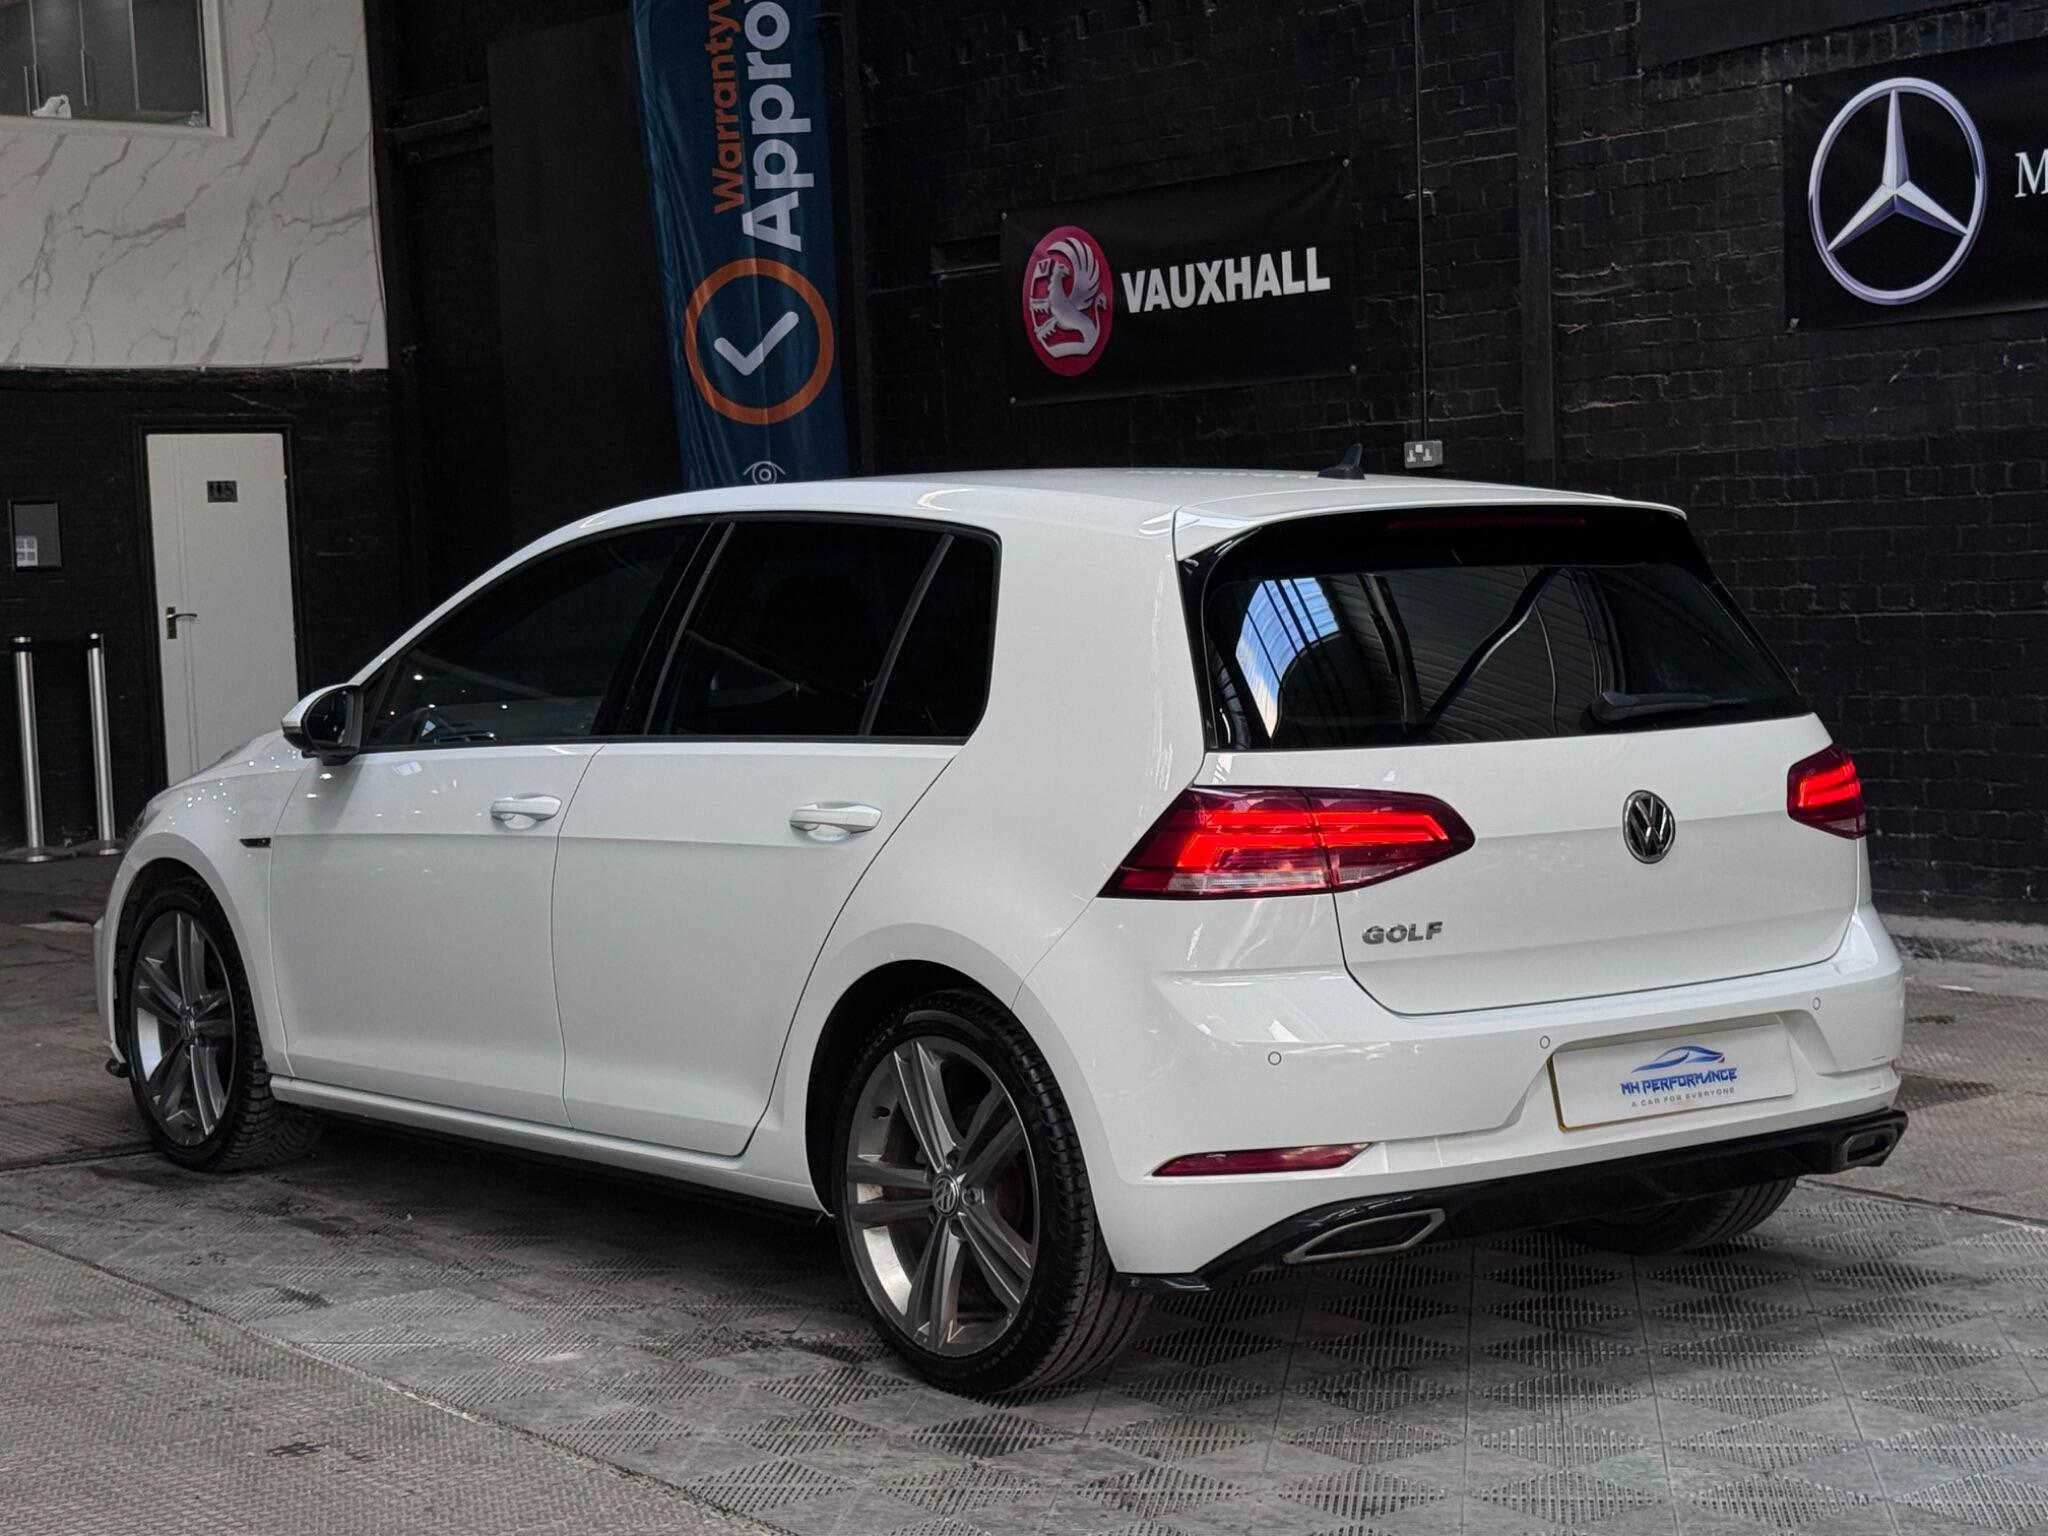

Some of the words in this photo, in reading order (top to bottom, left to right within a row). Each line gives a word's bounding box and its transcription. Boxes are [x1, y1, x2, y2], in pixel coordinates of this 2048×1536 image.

[742, 0, 815, 253] Appro
[2015, 148, 2048, 197] M
[1121, 247, 1331, 313] VAUXHALL
[1361, 920, 1443, 945] GOLF
[1621, 1082, 1641, 1095] MH
[1641, 1068, 1738, 1094] PERFORMANCE
[1641, 1098, 1660, 1107] CAR
[1664, 1095, 1682, 1104] FOR
[1685, 1087, 1735, 1100] EVERYONE
